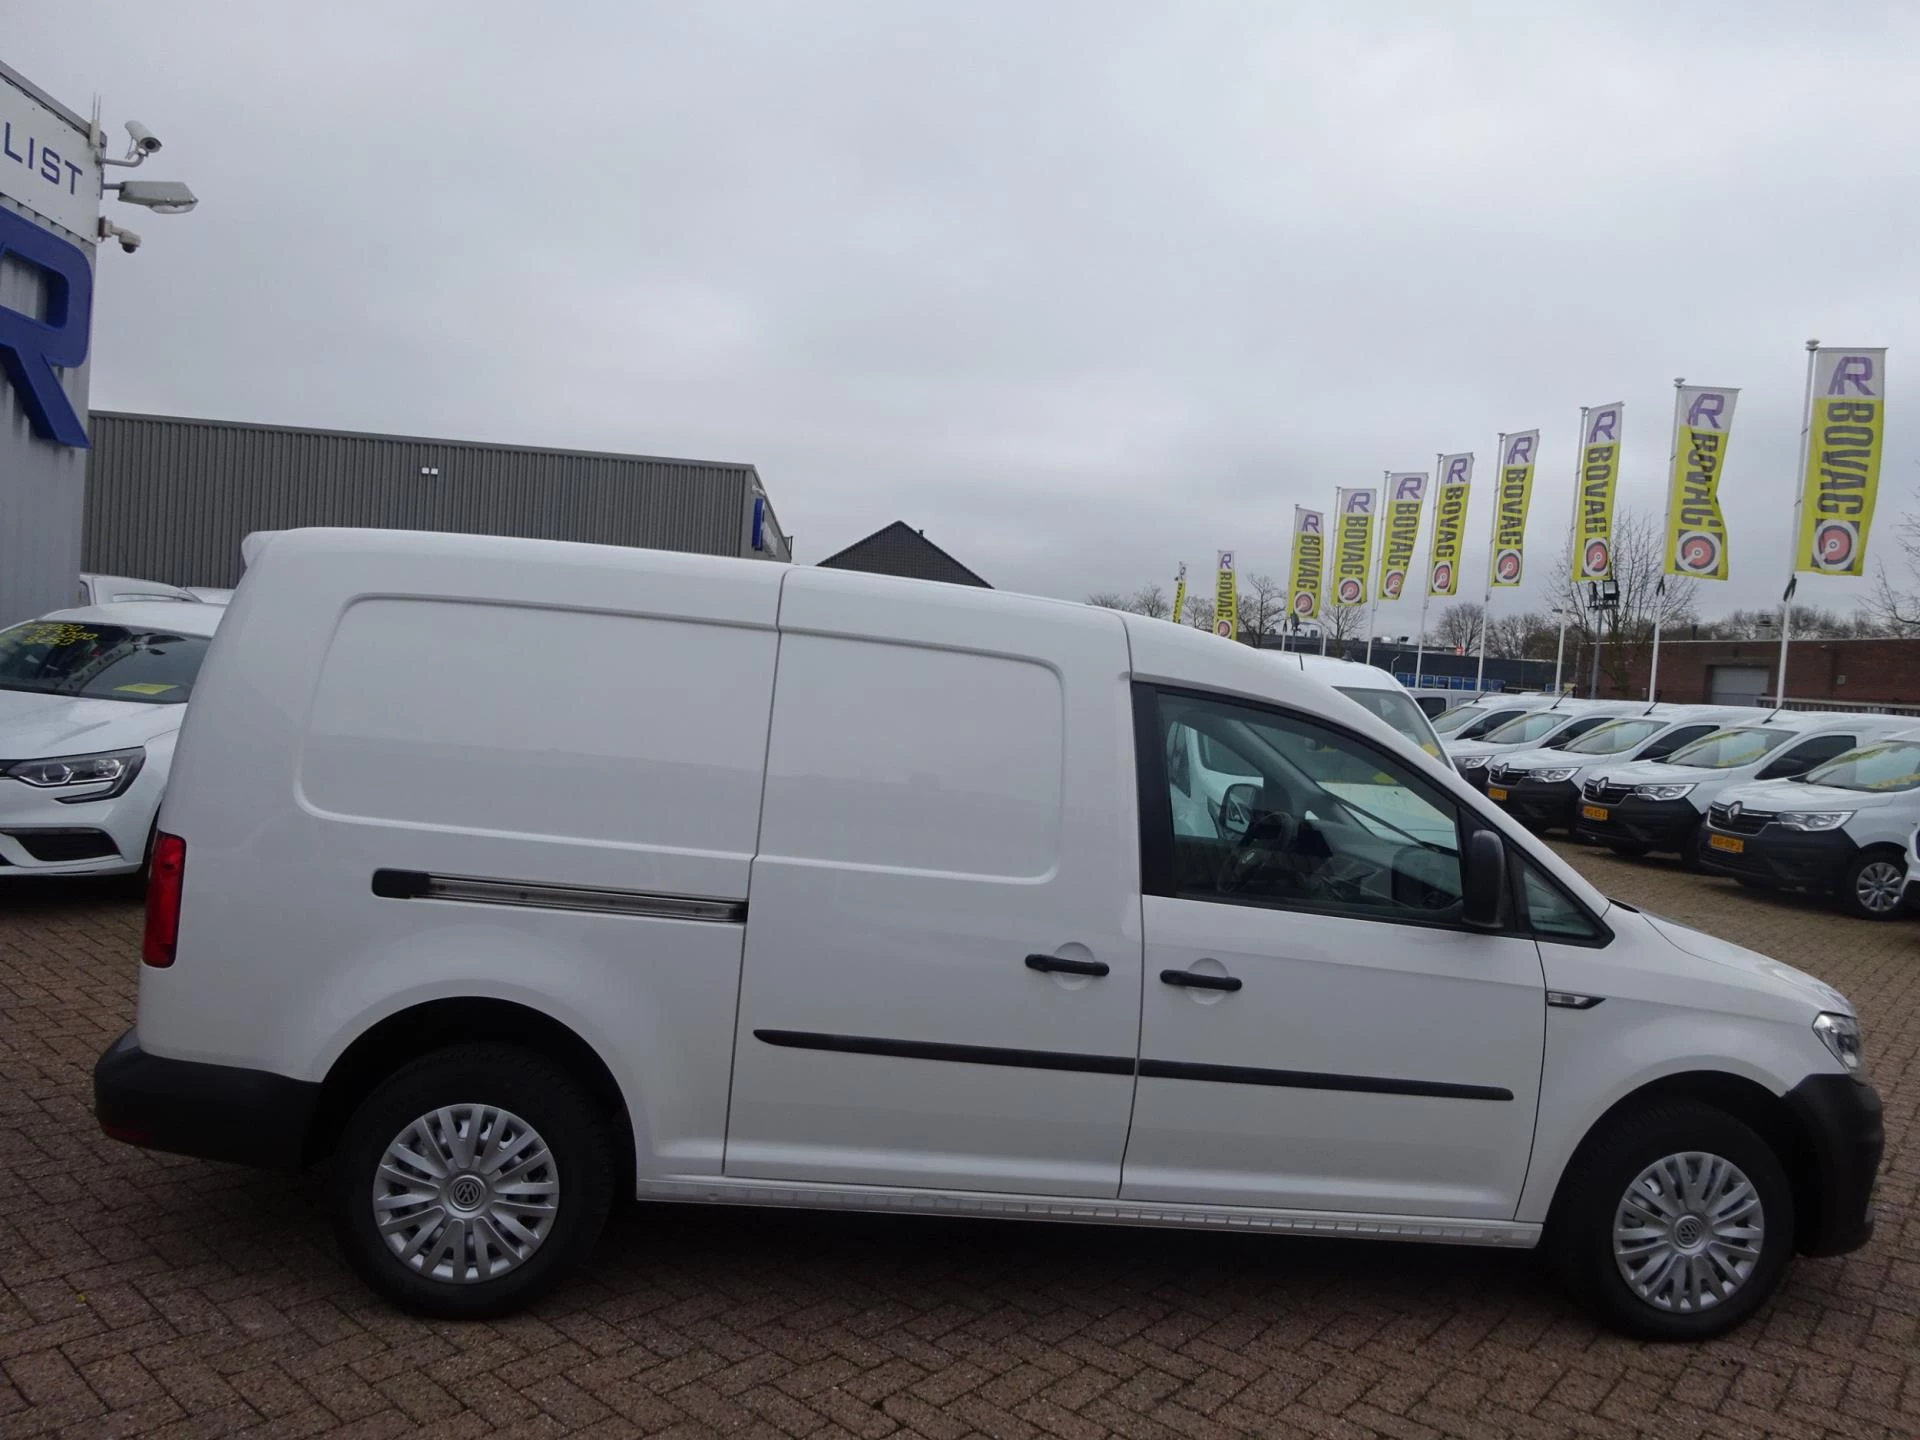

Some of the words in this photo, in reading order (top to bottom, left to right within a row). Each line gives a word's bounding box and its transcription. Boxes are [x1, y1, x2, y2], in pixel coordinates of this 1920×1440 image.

[4, 122, 83, 196] LIST
[1827, 357, 1876, 396] R
[1588, 410, 1617, 443] R
[1687, 393, 1725, 430] R
[1446, 458, 1468, 484] R
[1507, 436, 1533, 465] R
[1817, 402, 1875, 515] BOVAG
[1346, 492, 1371, 513] R
[1396, 477, 1422, 500] R
[1499, 468, 1528, 546] BOVAG
[1340, 516, 1369, 576] BOVAG
[1388, 503, 1419, 571] BOVAG
[1436, 486, 1465, 562] BOVAG
[1296, 535, 1321, 591] BOVAG
[1217, 572, 1233, 618] BOVAG
